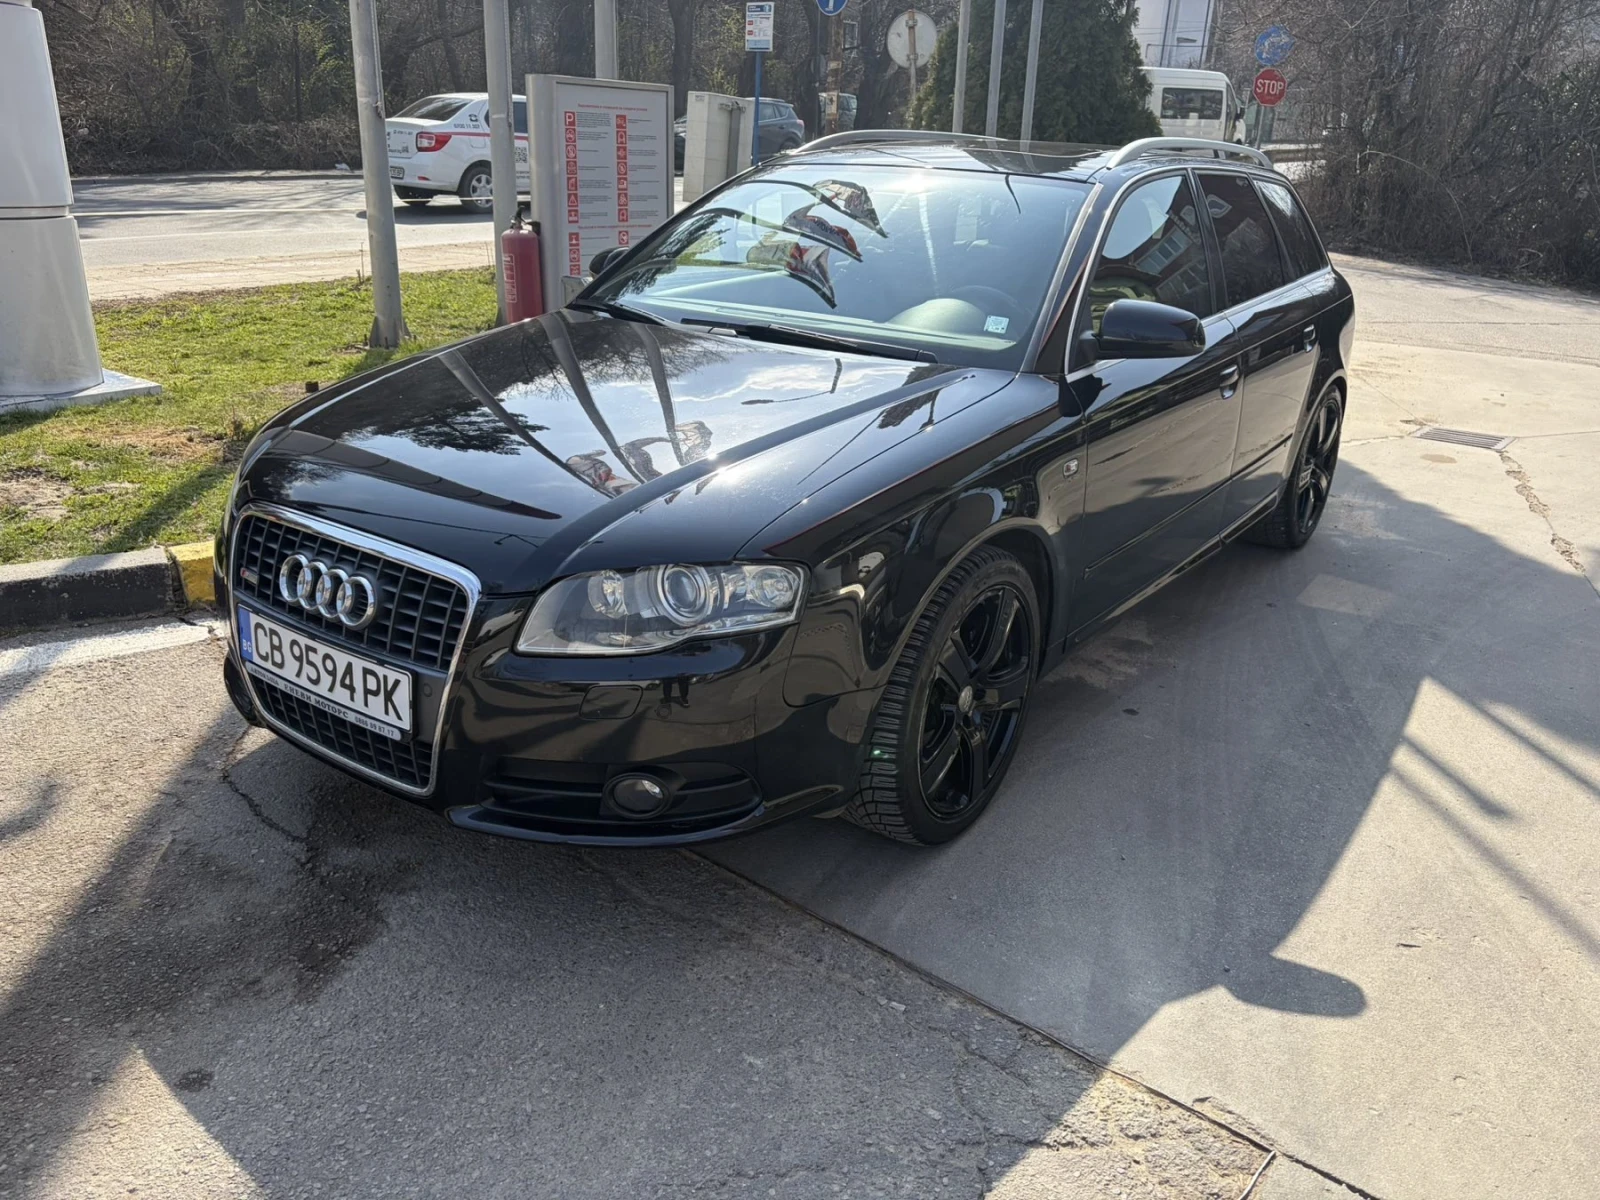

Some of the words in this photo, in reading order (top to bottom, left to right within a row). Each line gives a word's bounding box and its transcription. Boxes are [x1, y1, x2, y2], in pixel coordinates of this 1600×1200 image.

[1256, 79, 1284, 96] STOP
[566, 113, 574, 125] P
[242, 638, 252, 653] BG
[253, 621, 285, 670] CB
[290, 638, 356, 703] 9594
[362, 666, 403, 722] PK
